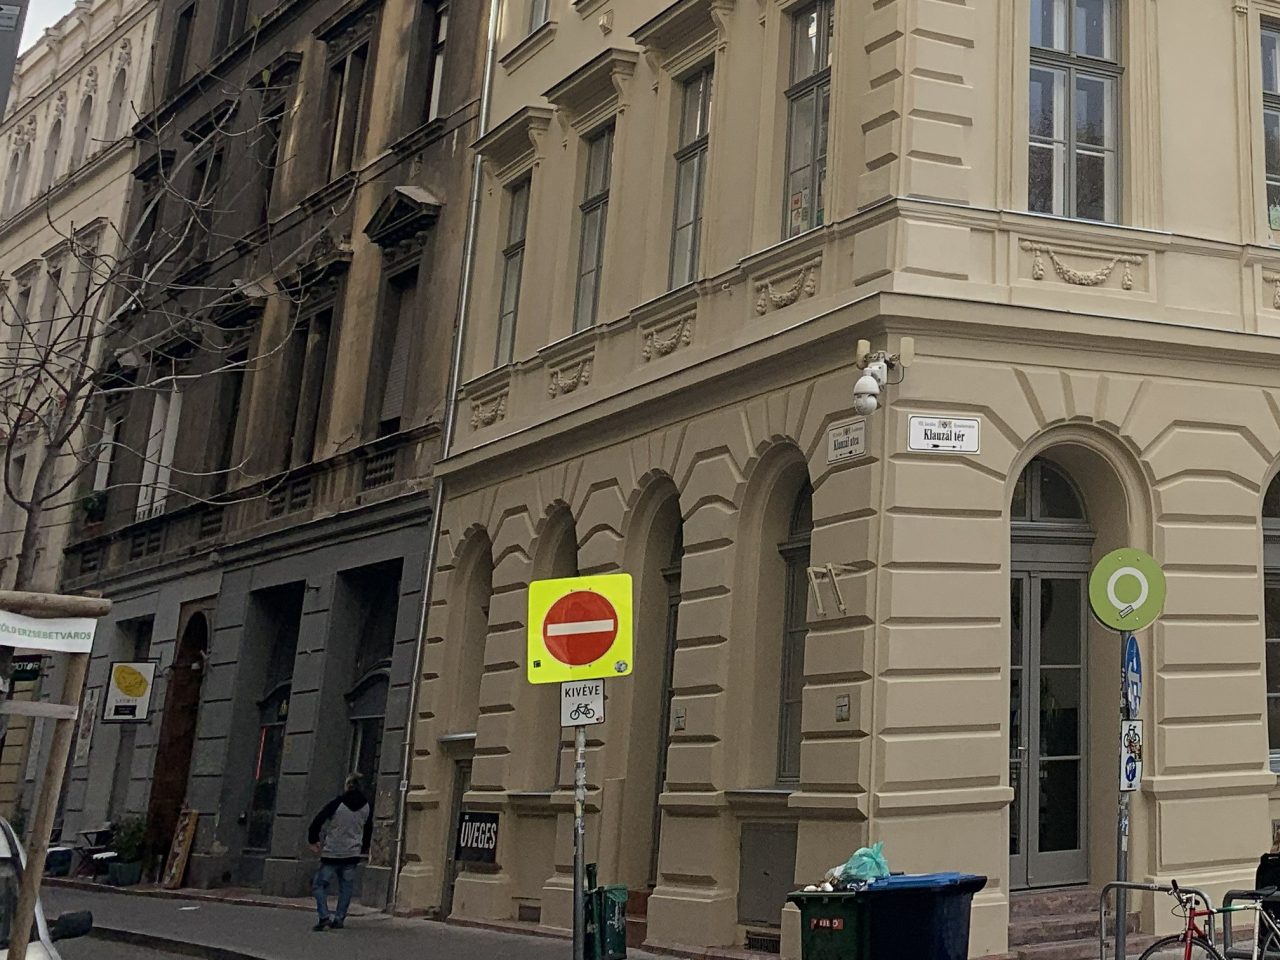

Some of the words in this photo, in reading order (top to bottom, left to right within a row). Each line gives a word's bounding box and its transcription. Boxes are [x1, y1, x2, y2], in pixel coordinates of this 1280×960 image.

[924, 428, 952, 441] Klauzál
[954, 430, 965, 442] tér
[564, 684, 600, 698] KIVÉVE
